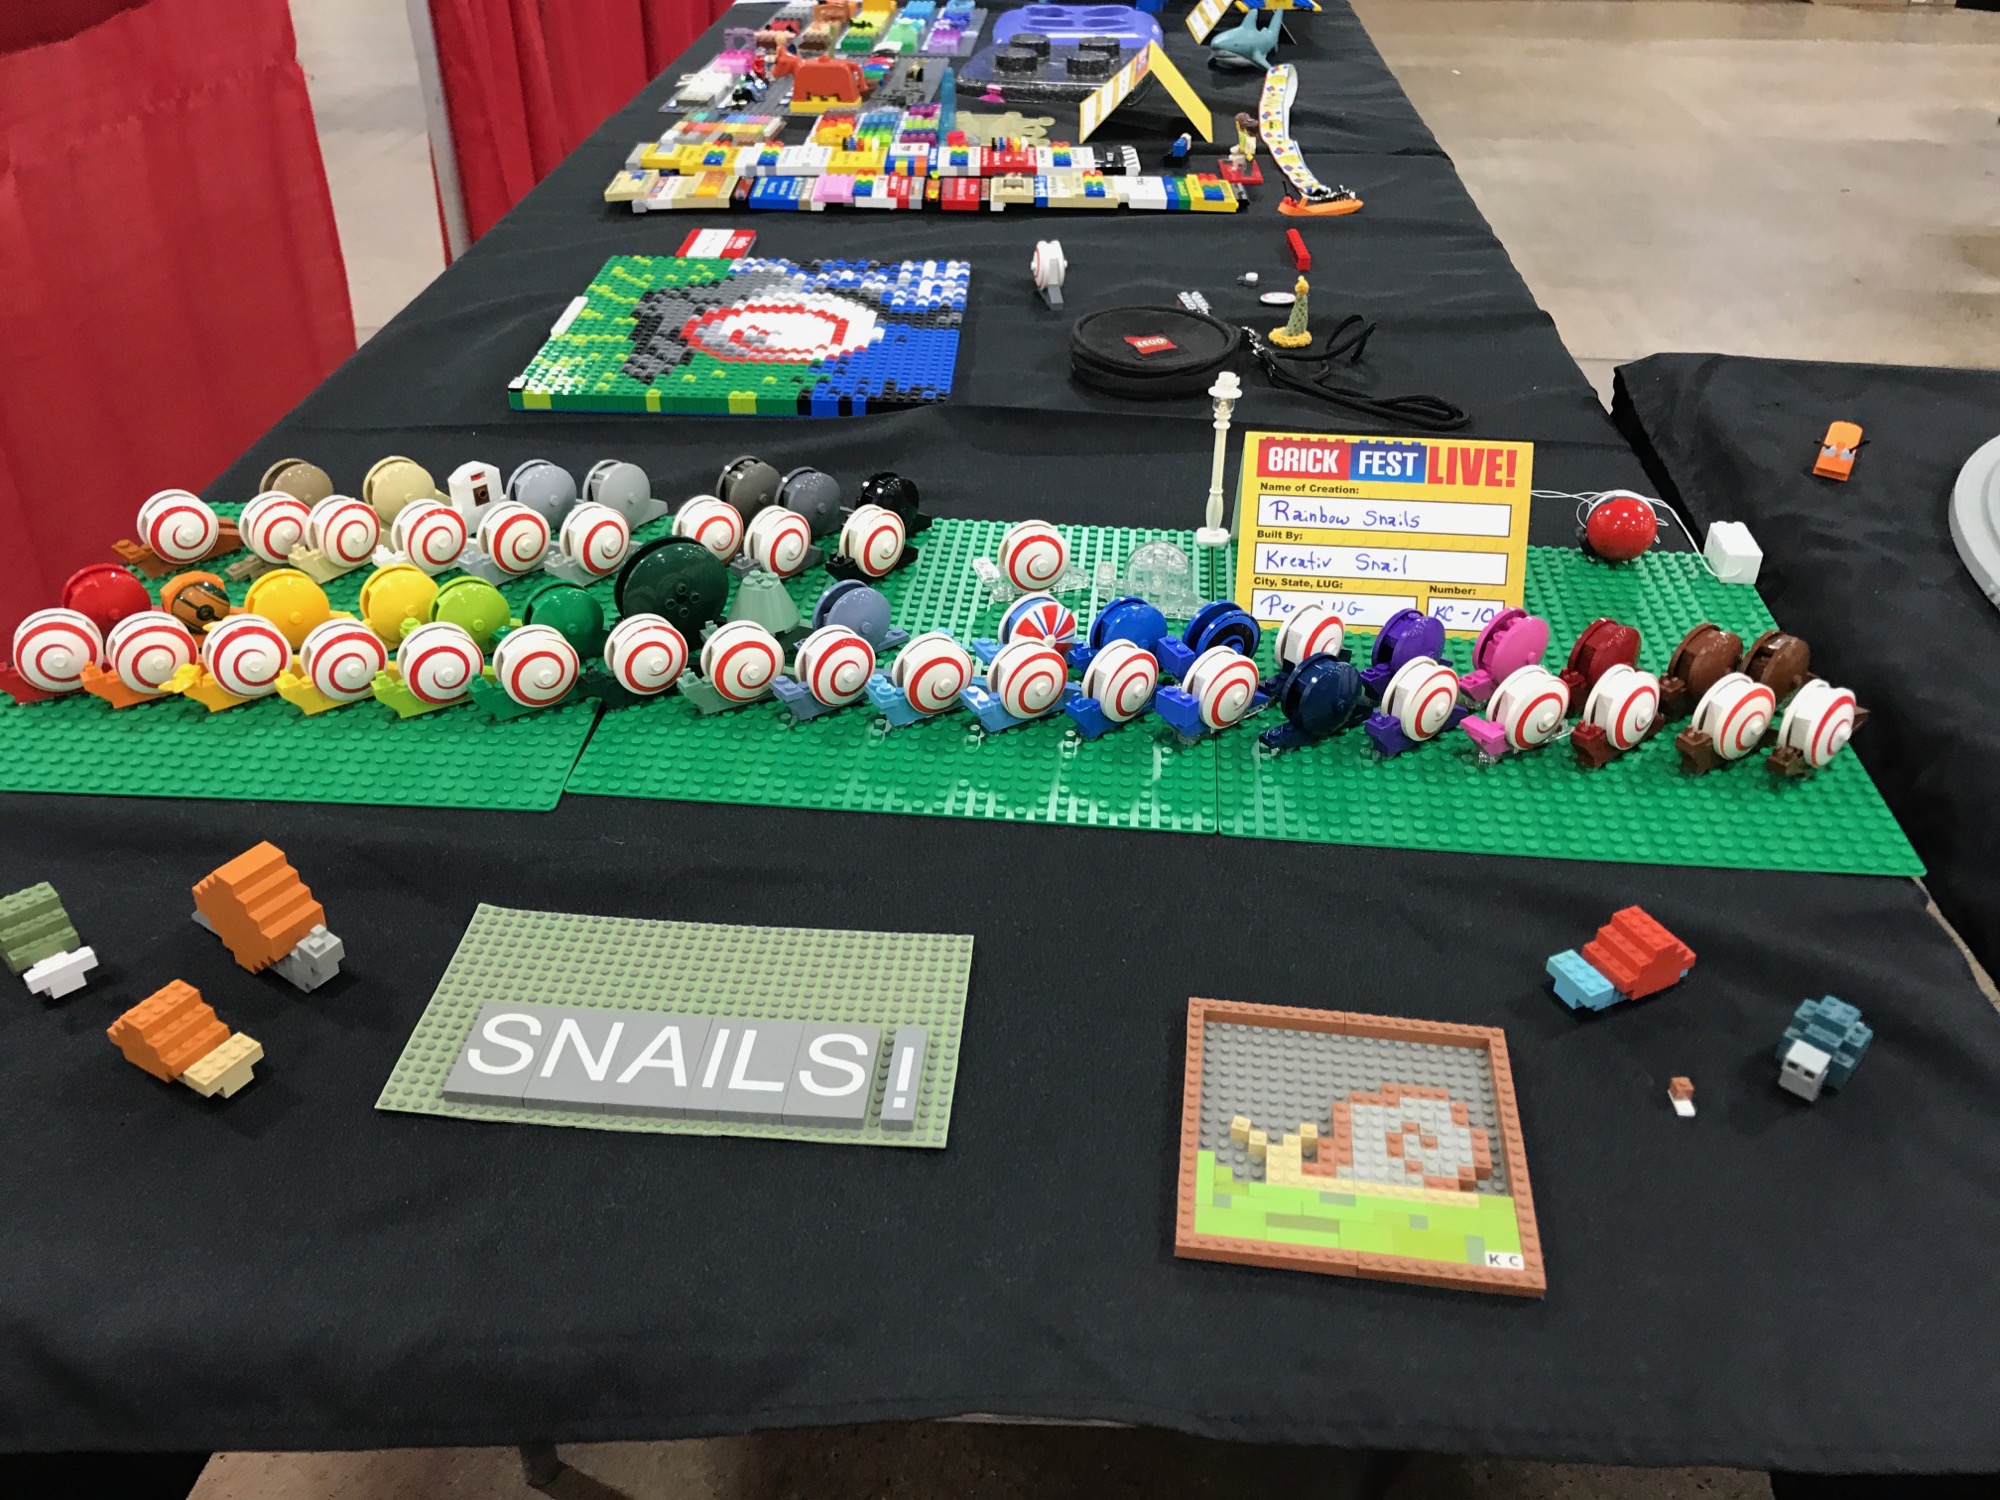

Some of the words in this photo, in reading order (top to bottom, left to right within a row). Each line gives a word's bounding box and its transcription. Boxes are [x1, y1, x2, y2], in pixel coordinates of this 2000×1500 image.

[1135, 337, 1168, 348] LEGO
[1267, 446, 1340, 474] BRICK
[1358, 450, 1419, 477] FEST
[1427, 446, 1517, 487] LIVE!
[1260, 482, 1291, 492] Name
[1294, 484, 1306, 492] of
[1309, 484, 1360, 494] Creation:
[1268, 500, 1350, 526] Rainbow
[1362, 510, 1420, 529] Snails
[1256, 530, 1282, 540] Built
[1285, 531, 1303, 541] By:
[1265, 550, 1332, 570] Kreativ
[1355, 553, 1407, 575] Snail
[1253, 576, 1278, 588] City,
[1281, 578, 1314, 589] State,
[1316, 580, 1343, 589] LUG:
[1429, 585, 1477, 596] Number:
[467, 1013, 914, 1109] SNAILS!
